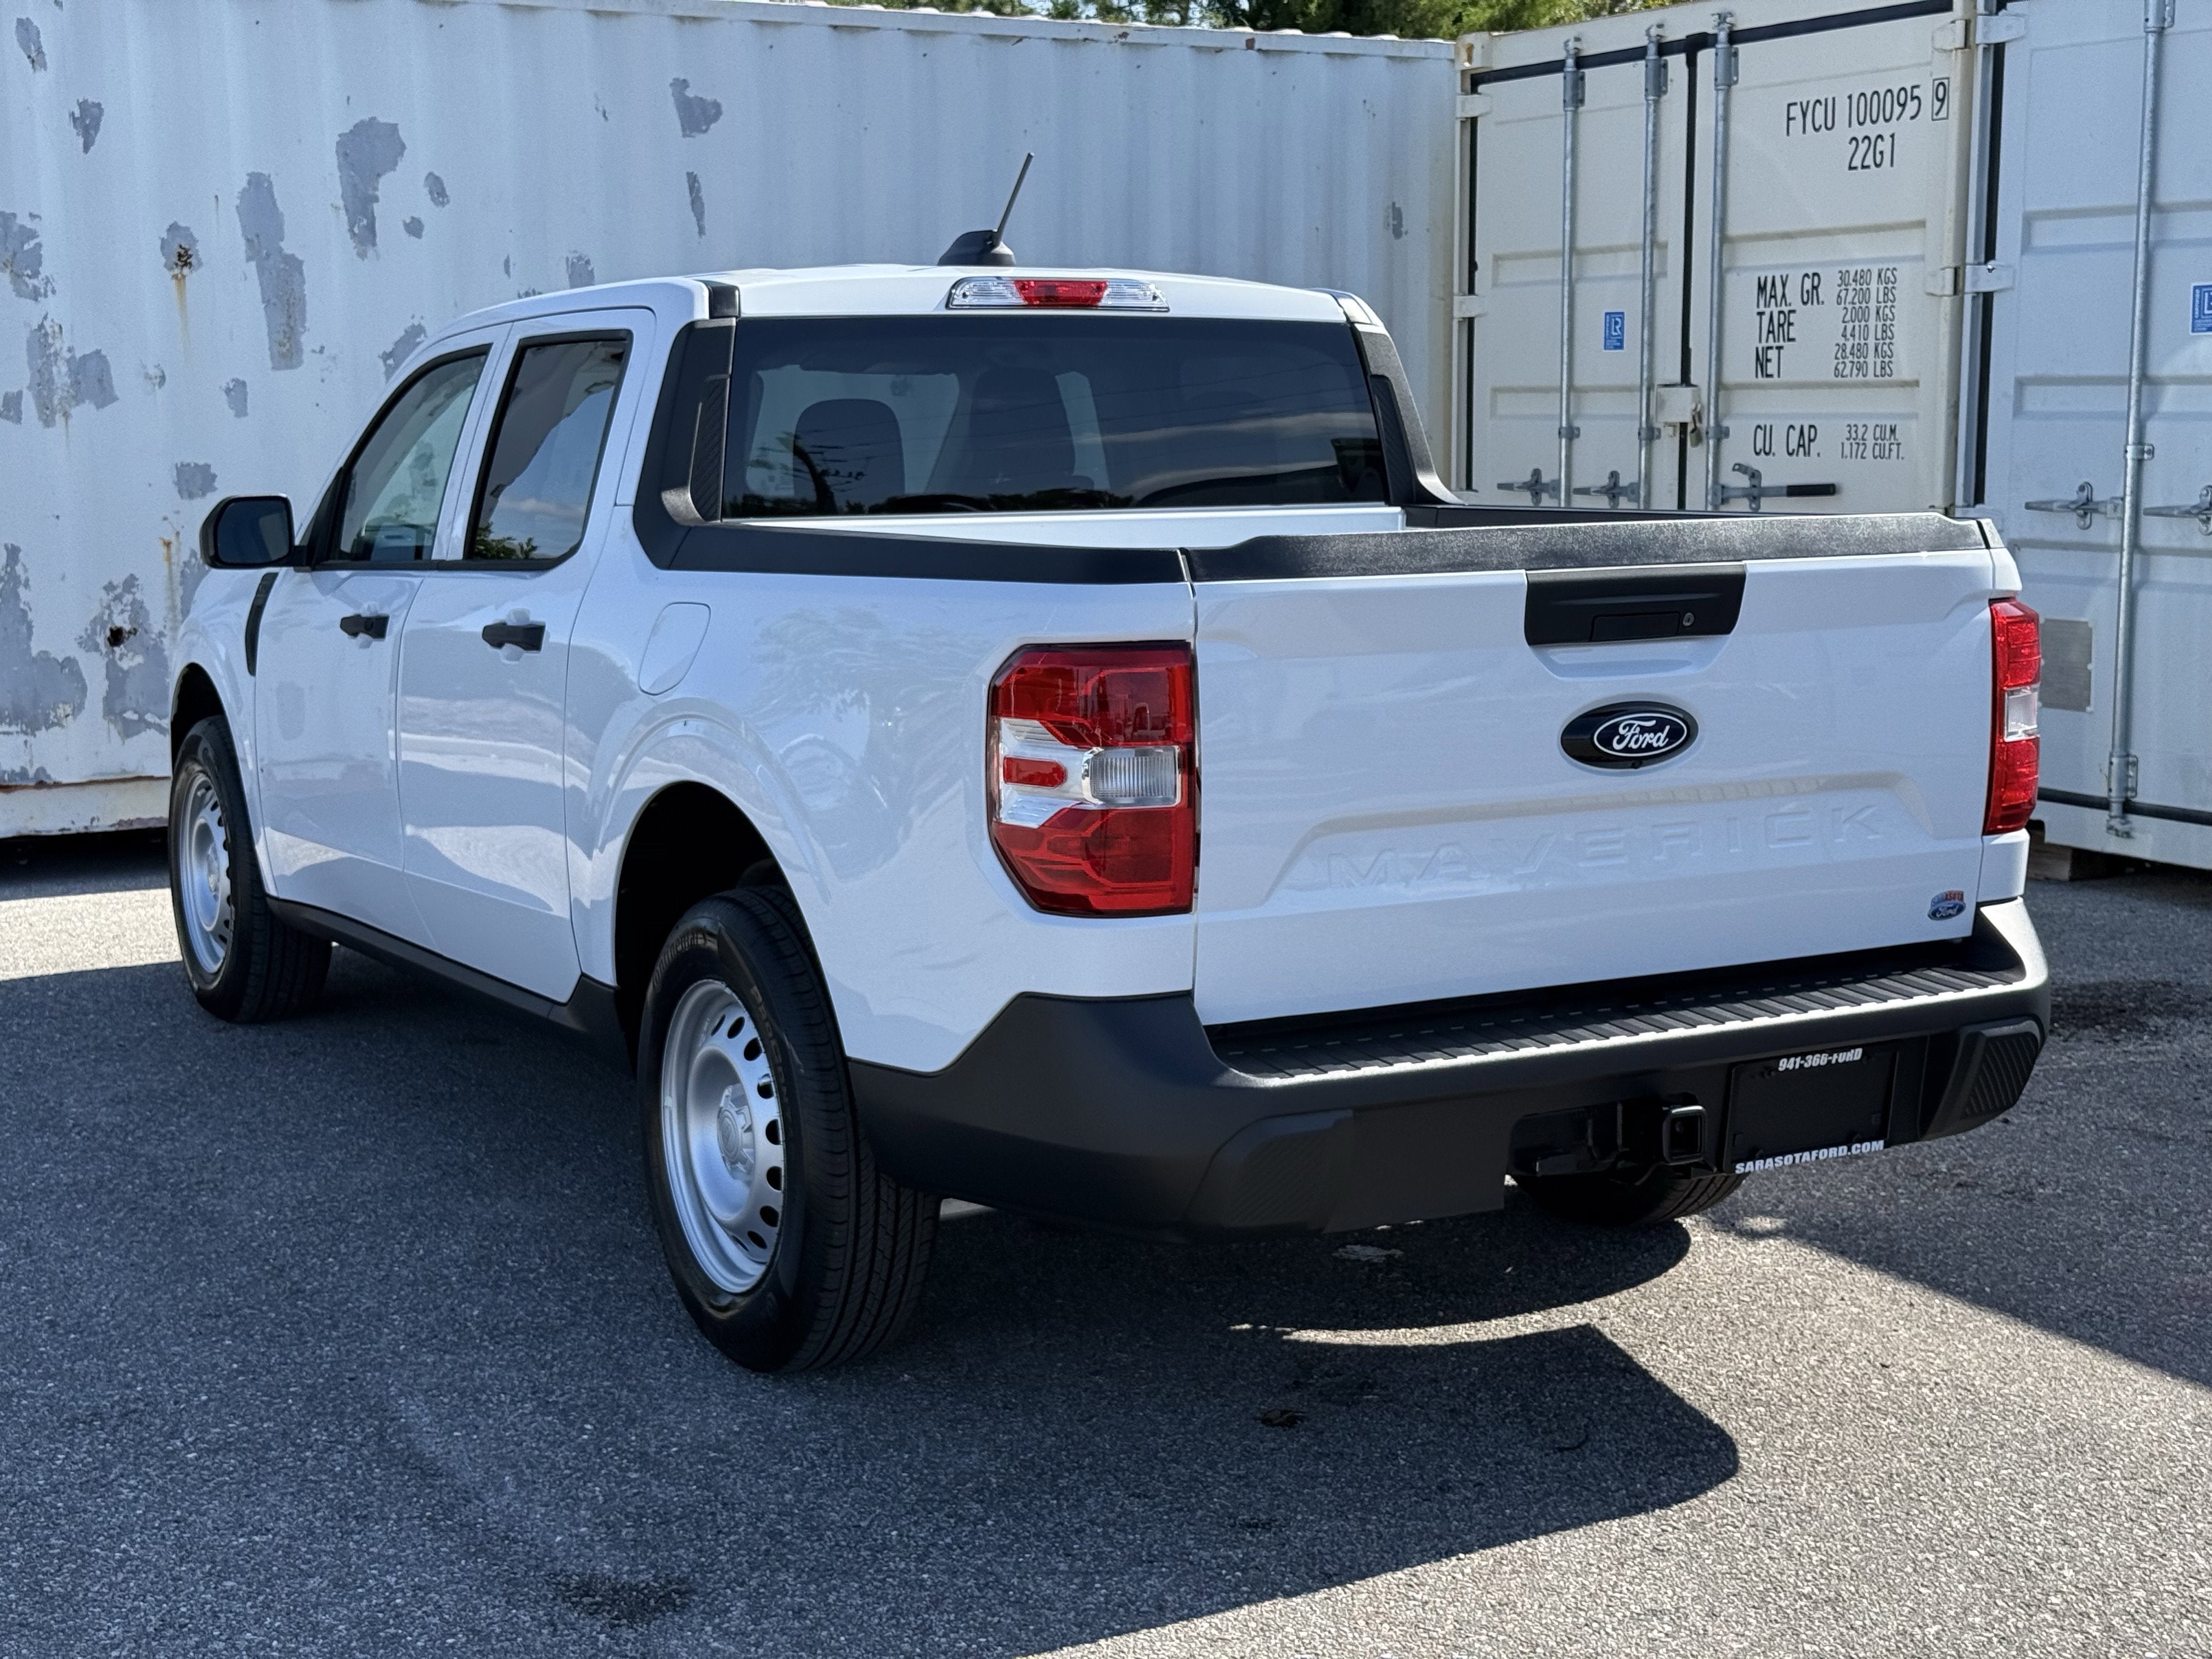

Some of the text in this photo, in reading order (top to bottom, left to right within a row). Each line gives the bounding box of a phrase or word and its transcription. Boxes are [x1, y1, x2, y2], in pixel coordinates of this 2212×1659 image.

[1786, 81, 1947, 137] FYCU 100095 9
[1847, 132, 1895, 171] 22G1
[1757, 272, 1825, 309] MAX. GR.
[1837, 267, 1897, 287] 30.480 KGS
[1836, 286, 1897, 306] 67.200 LBS
[1756, 309, 1797, 344] TARE
[1875, 304, 1895, 323] KGS
[1875, 323, 1894, 341] LBS
[1755, 346, 1784, 379] NET
[1874, 341, 1894, 359] KGS
[1874, 360, 1893, 377] LBS
[1753, 424, 1821, 458] CU. CAP.
[1846, 424, 1869, 442] 33.2
[1841, 442, 1867, 460] 1.172
[1612, 720, 1670, 750] Ford
[1327, 804, 1883, 889] MAVERICK
[1735, 1139, 1884, 1175] SARASOTAFORD.COM
